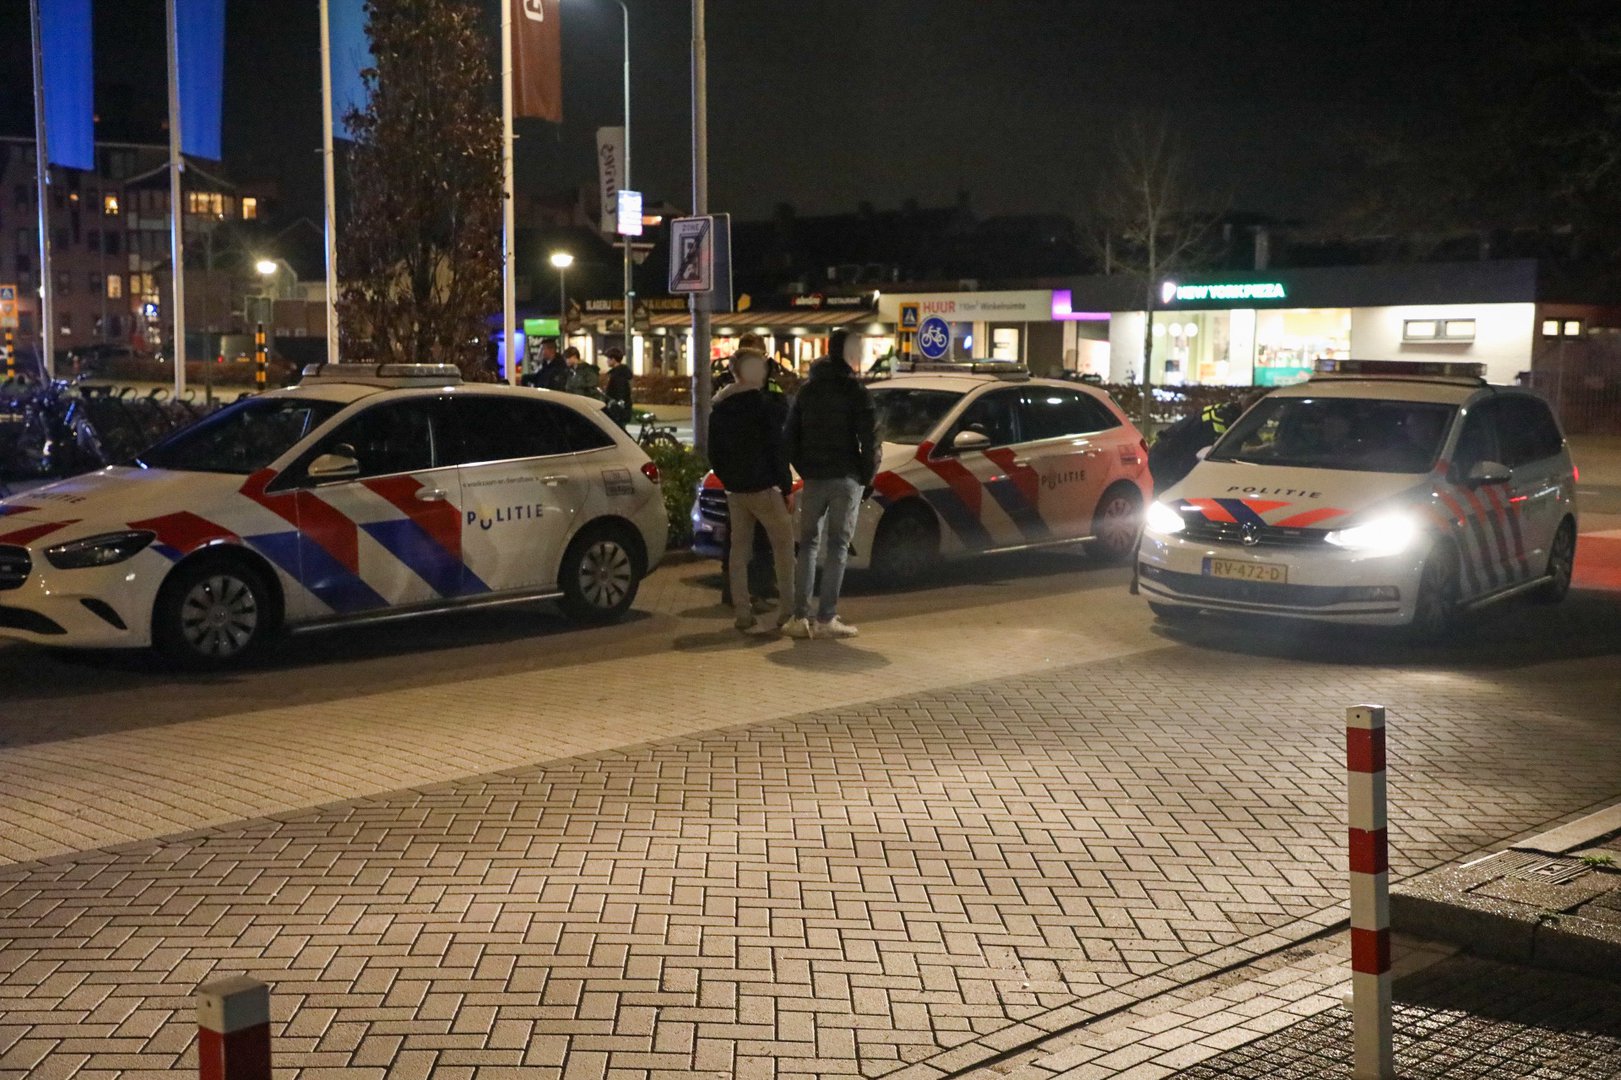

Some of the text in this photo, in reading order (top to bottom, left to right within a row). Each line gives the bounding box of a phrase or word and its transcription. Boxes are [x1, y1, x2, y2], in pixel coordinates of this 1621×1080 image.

[1177, 283, 1285, 299] NEW YORK PIZZA
[923, 301, 956, 313] HUUR
[1042, 470, 1086, 490] POLITIE
[1227, 486, 1322, 499] POLITIE
[467, 504, 543, 530] POLITIE
[1213, 562, 1280, 581] RV-472-D
